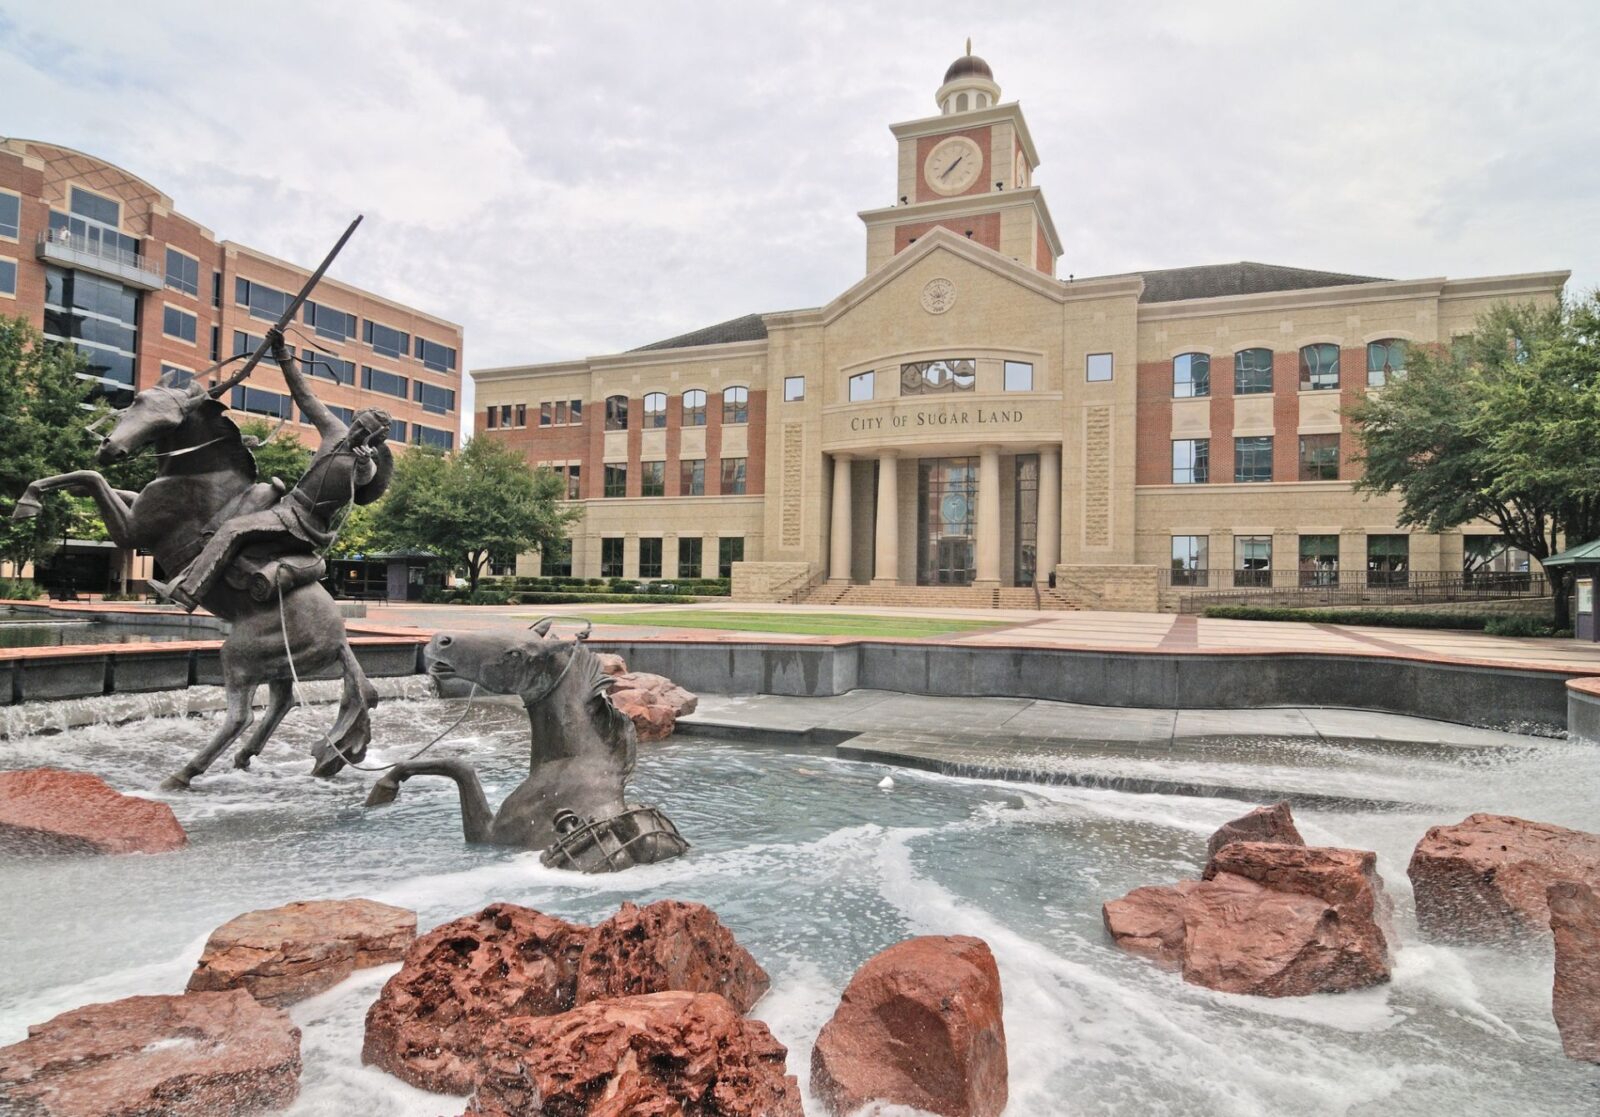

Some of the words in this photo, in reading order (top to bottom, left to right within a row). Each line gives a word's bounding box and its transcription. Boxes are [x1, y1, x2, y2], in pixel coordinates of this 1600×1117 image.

[851, 417, 883, 431] CITY
[892, 415, 908, 428] OF
[917, 412, 969, 426] SUGAR
[978, 409, 1022, 424] LAND
